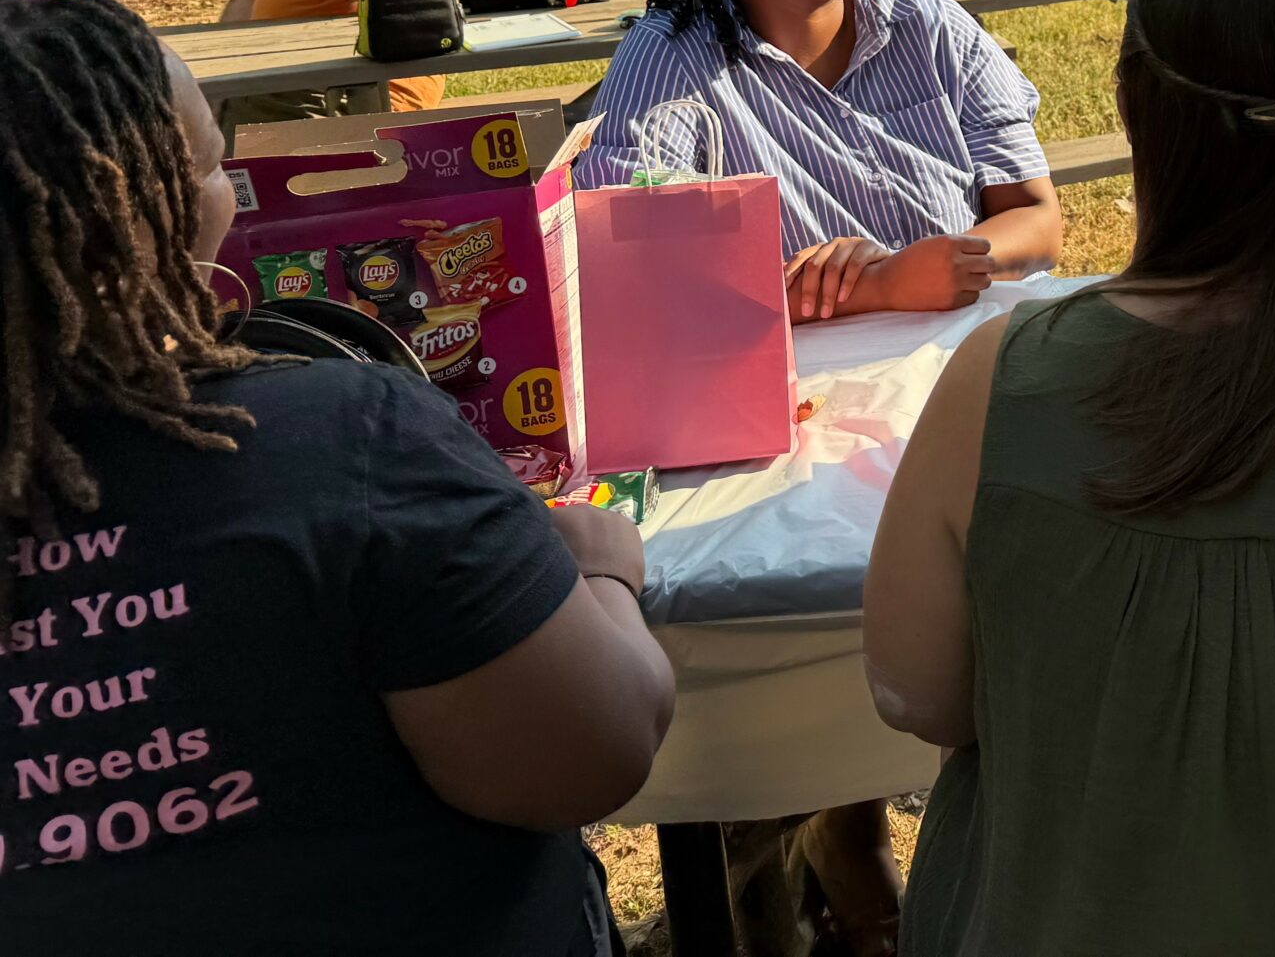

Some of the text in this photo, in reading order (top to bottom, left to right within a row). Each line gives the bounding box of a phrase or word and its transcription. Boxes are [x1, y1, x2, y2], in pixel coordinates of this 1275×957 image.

[483, 128, 517, 160] 18
[435, 166, 460, 178] MIX
[488, 158, 520, 171] BAGS
[439, 231, 492, 276] Cheetos
[278, 273, 310, 293] Lay's
[363, 262, 396, 283] Lay's
[412, 321, 475, 360] Fritos
[517, 377, 554, 415] 18
[521, 412, 556, 427] BAGS
[72, 583, 190, 637] You
[8, 666, 156, 727] Your
[14, 727, 210, 799] Needs
